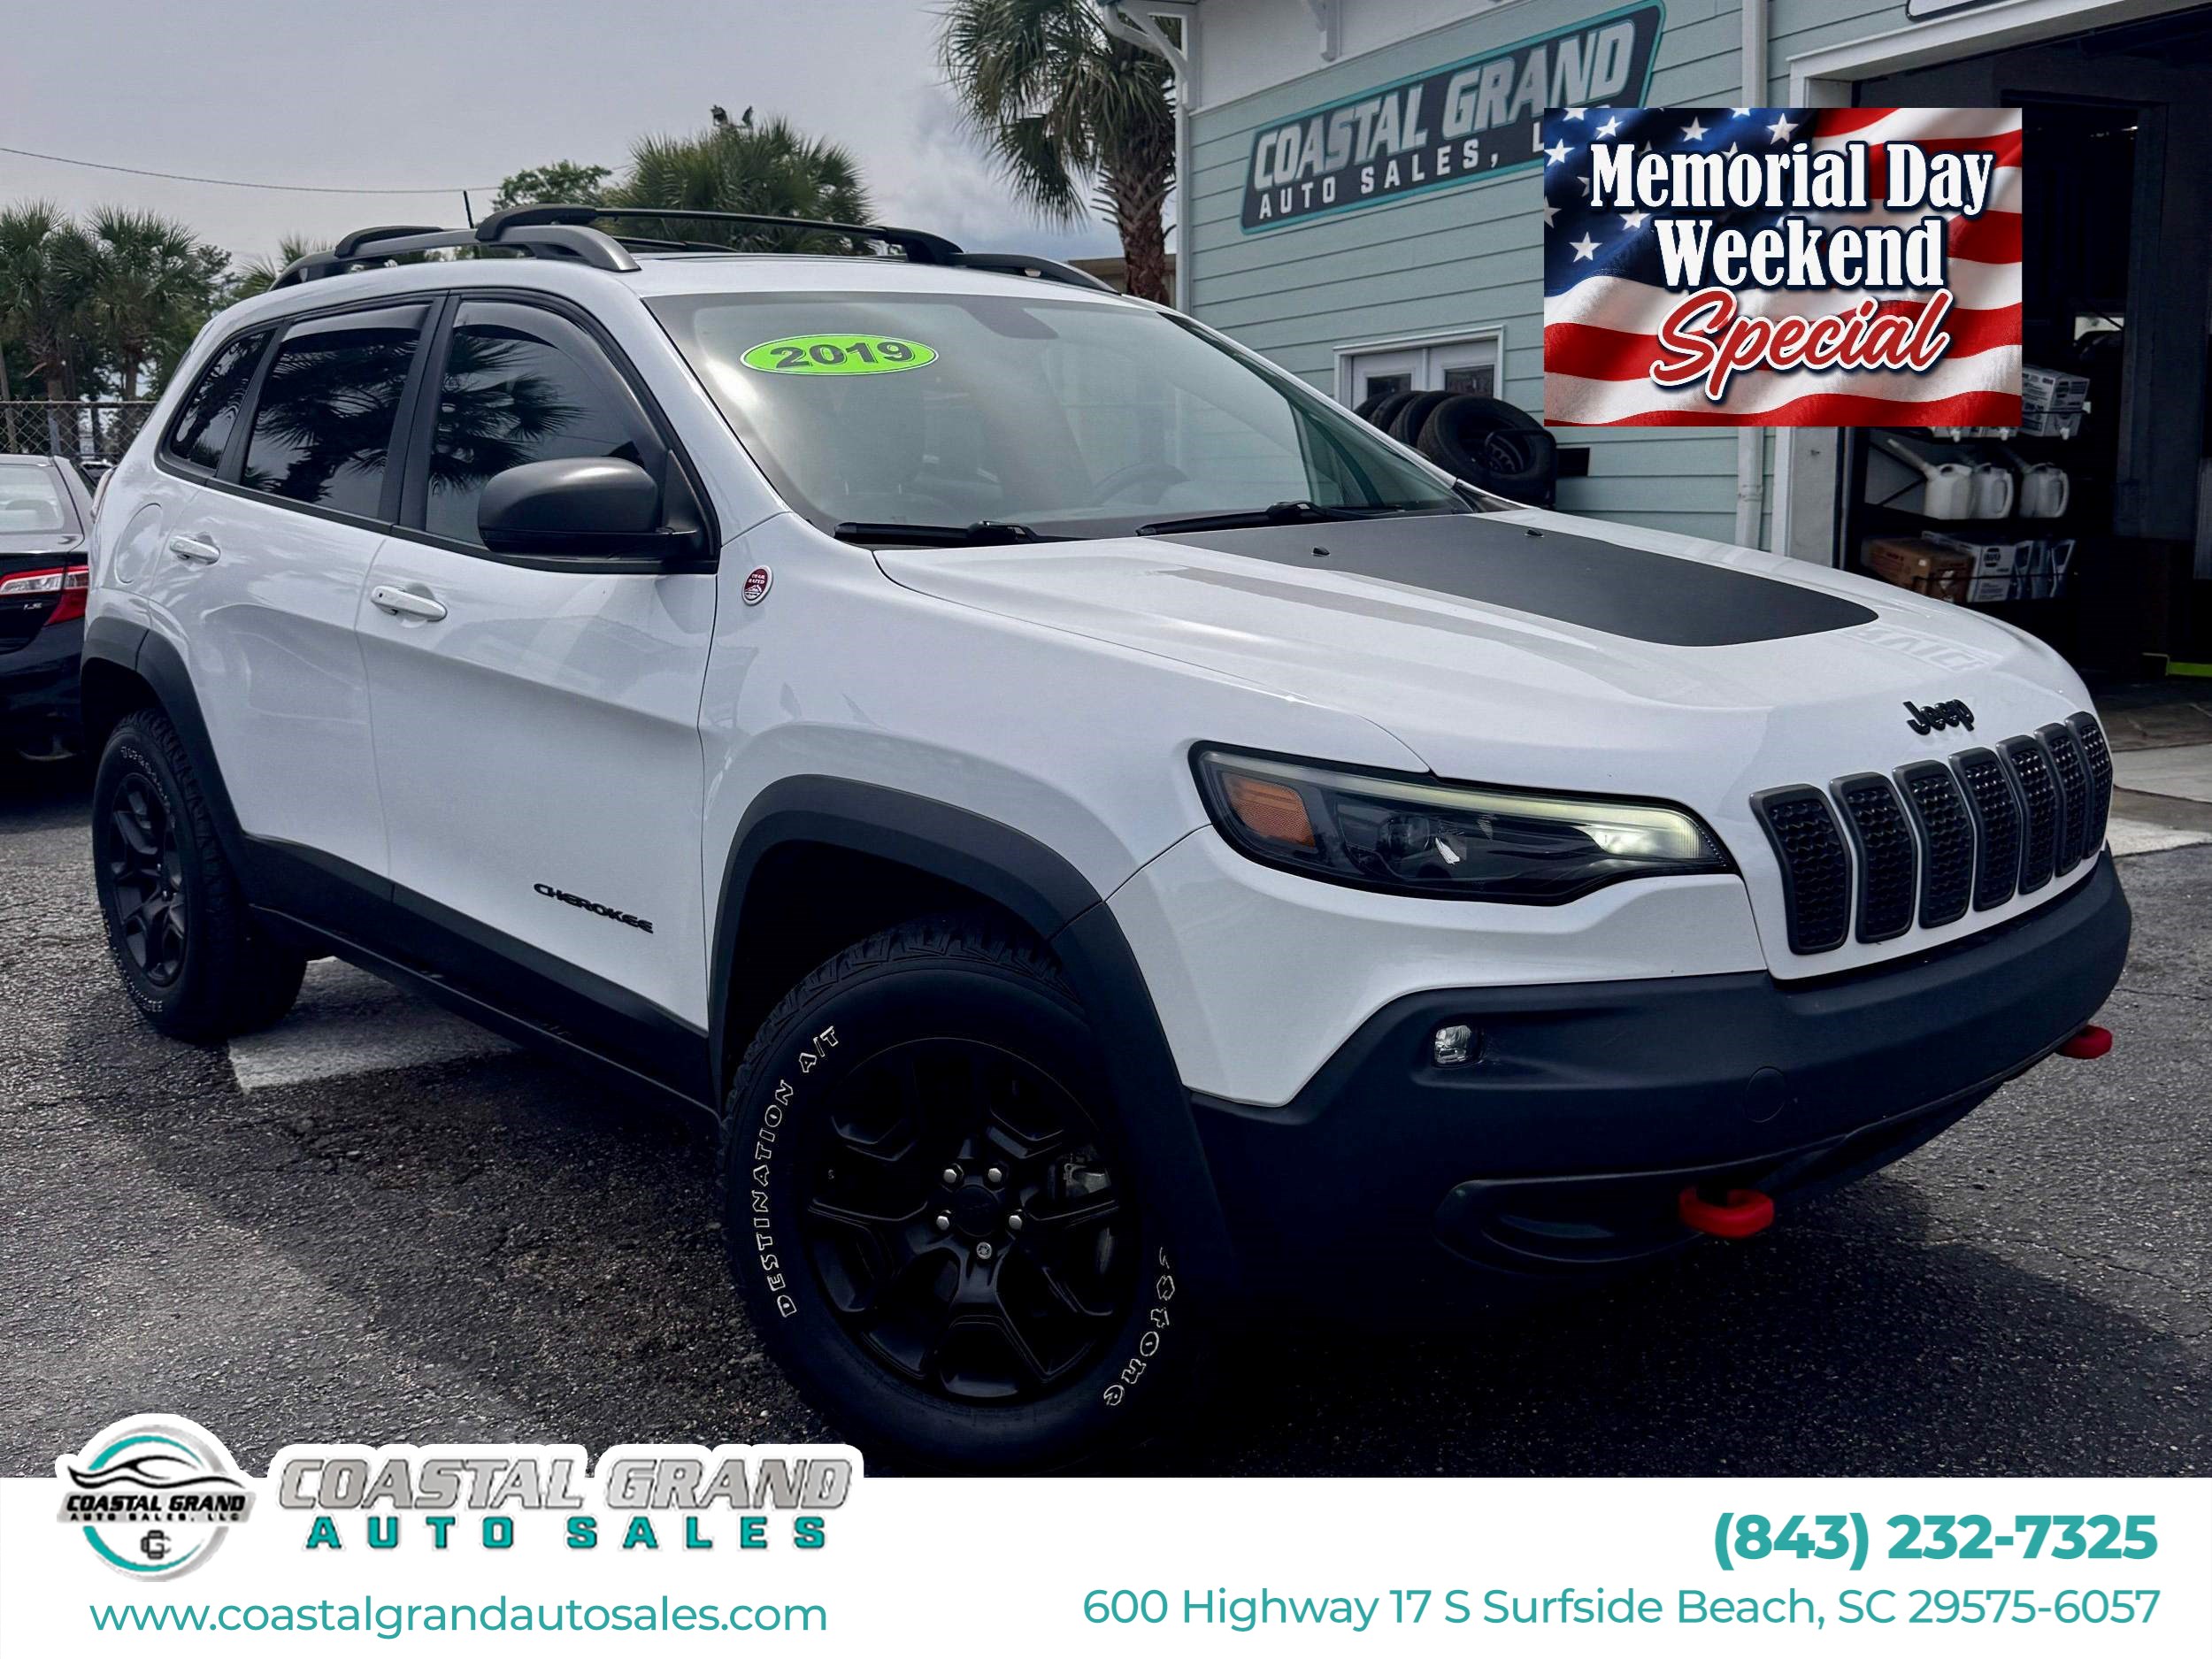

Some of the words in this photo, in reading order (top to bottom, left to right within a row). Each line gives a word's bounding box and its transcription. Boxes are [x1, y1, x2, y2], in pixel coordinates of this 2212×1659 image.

[1254, 85, 1427, 191] COASTAL
[1442, 19, 1636, 140] GRAND
[1259, 181, 1336, 219] AUTO
[1361, 138, 1500, 195] SALES,
[770, 342, 915, 369] 2019
[1902, 699, 1975, 735] Jeep
[534, 883, 654, 934] CHEROKEE
[752, 1079, 797, 1317] DESTINATION
[798, 1025, 840, 1073] A/T
